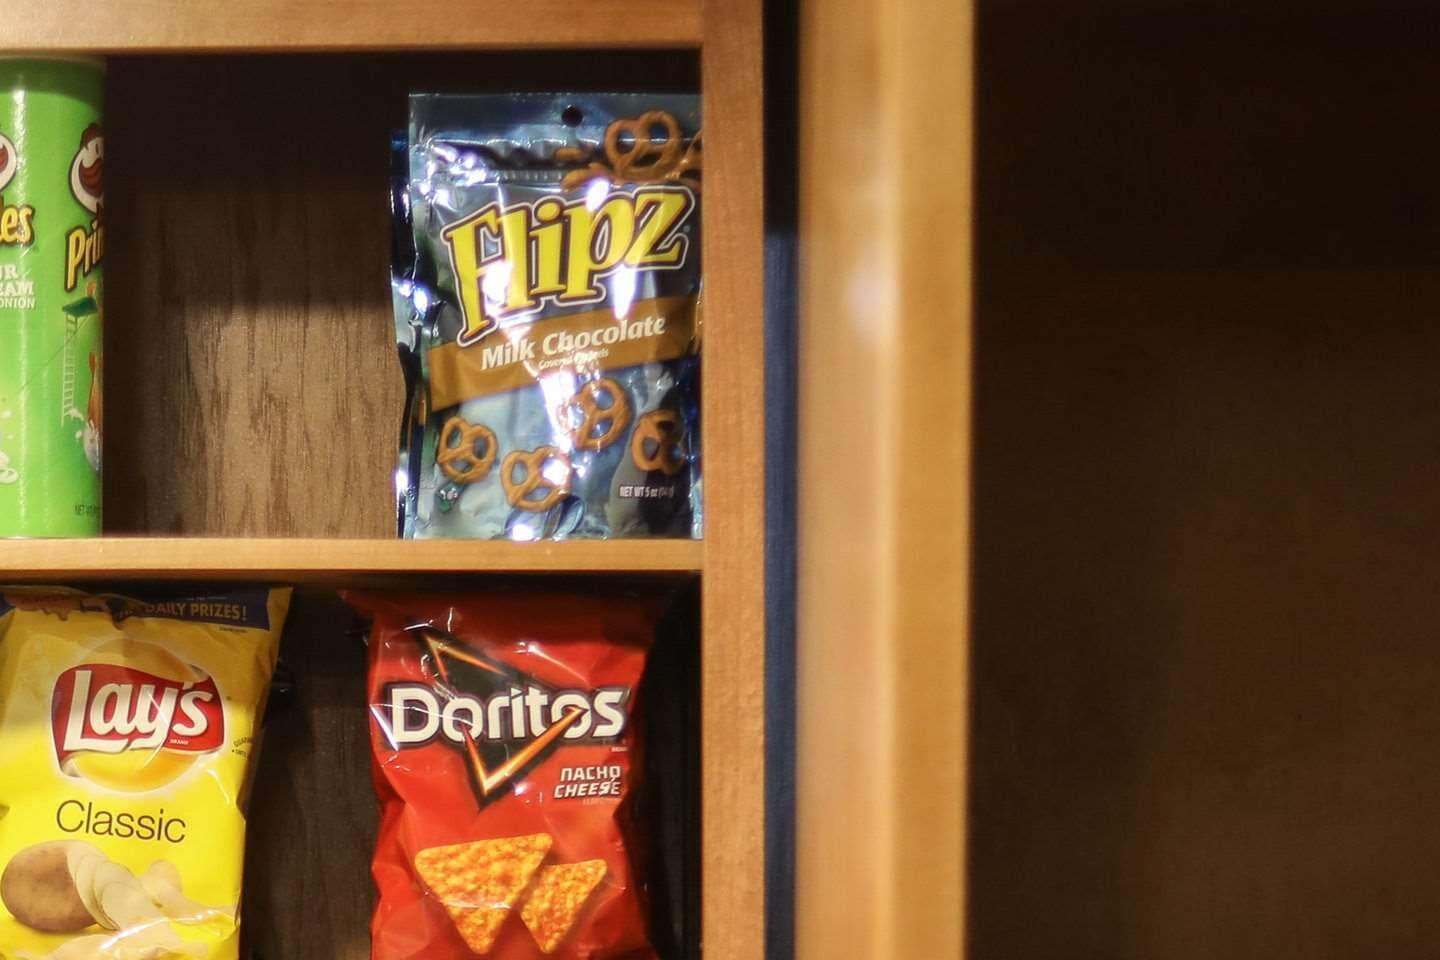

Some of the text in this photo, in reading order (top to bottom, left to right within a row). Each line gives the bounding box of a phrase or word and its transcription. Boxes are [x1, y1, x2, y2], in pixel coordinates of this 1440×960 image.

[480, 316, 666, 371] Milk Chocolate
[190, 603, 247, 621] PRIZES!
[63, 669, 213, 753] Lay's
[391, 687, 625, 743] Doritos
[554, 782, 621, 798] CHEESE
[560, 766, 621, 782] NACHO
[56, 800, 186, 843] Classic
